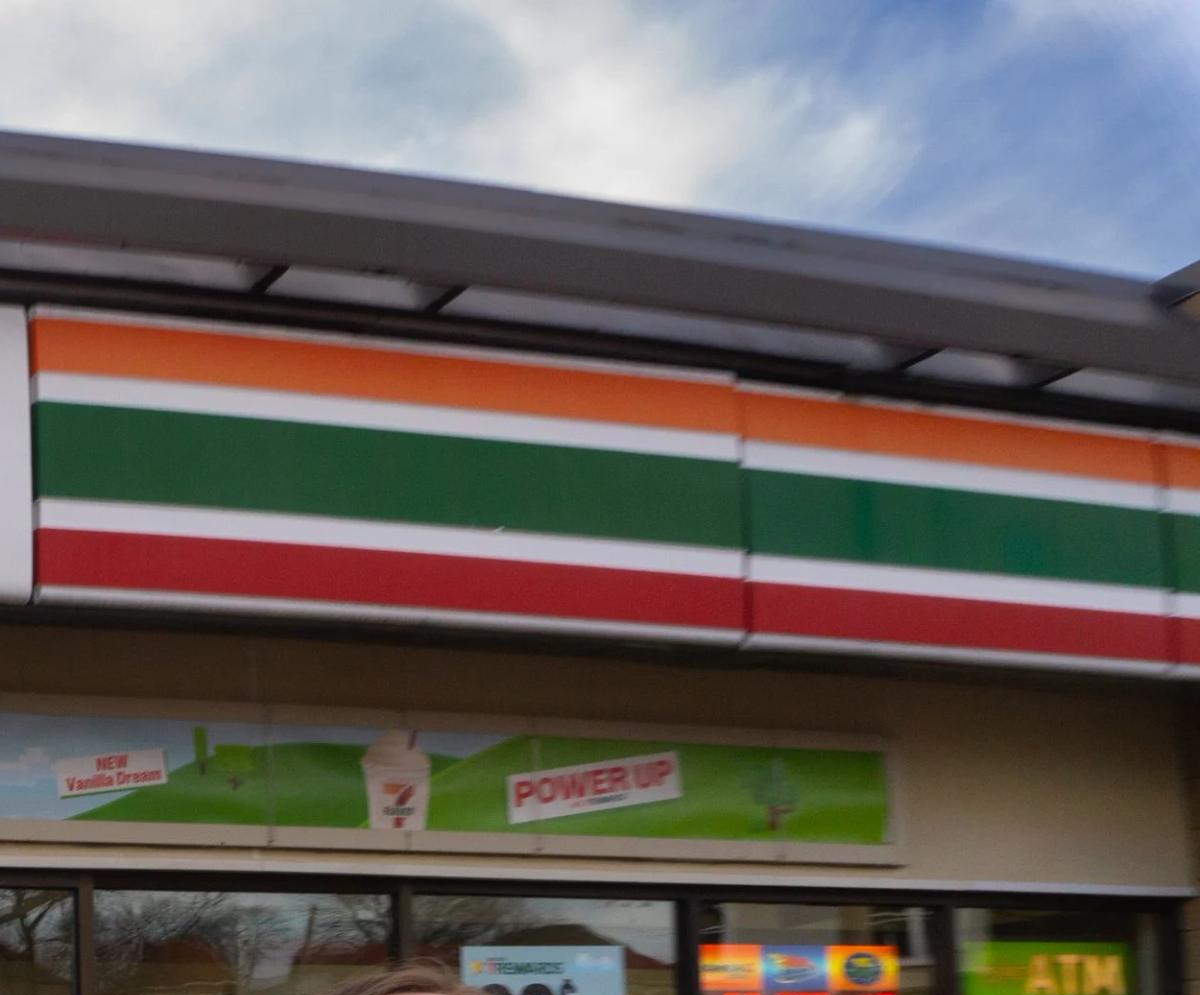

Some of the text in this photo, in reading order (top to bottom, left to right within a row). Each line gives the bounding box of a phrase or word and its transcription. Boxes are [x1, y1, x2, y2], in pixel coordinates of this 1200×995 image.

[96, 753, 129, 772] NEW
[65, 770, 163, 792] Vanilla Dream
[513, 758, 674, 808] POWER UP
[1024, 954, 1127, 995] ATM
